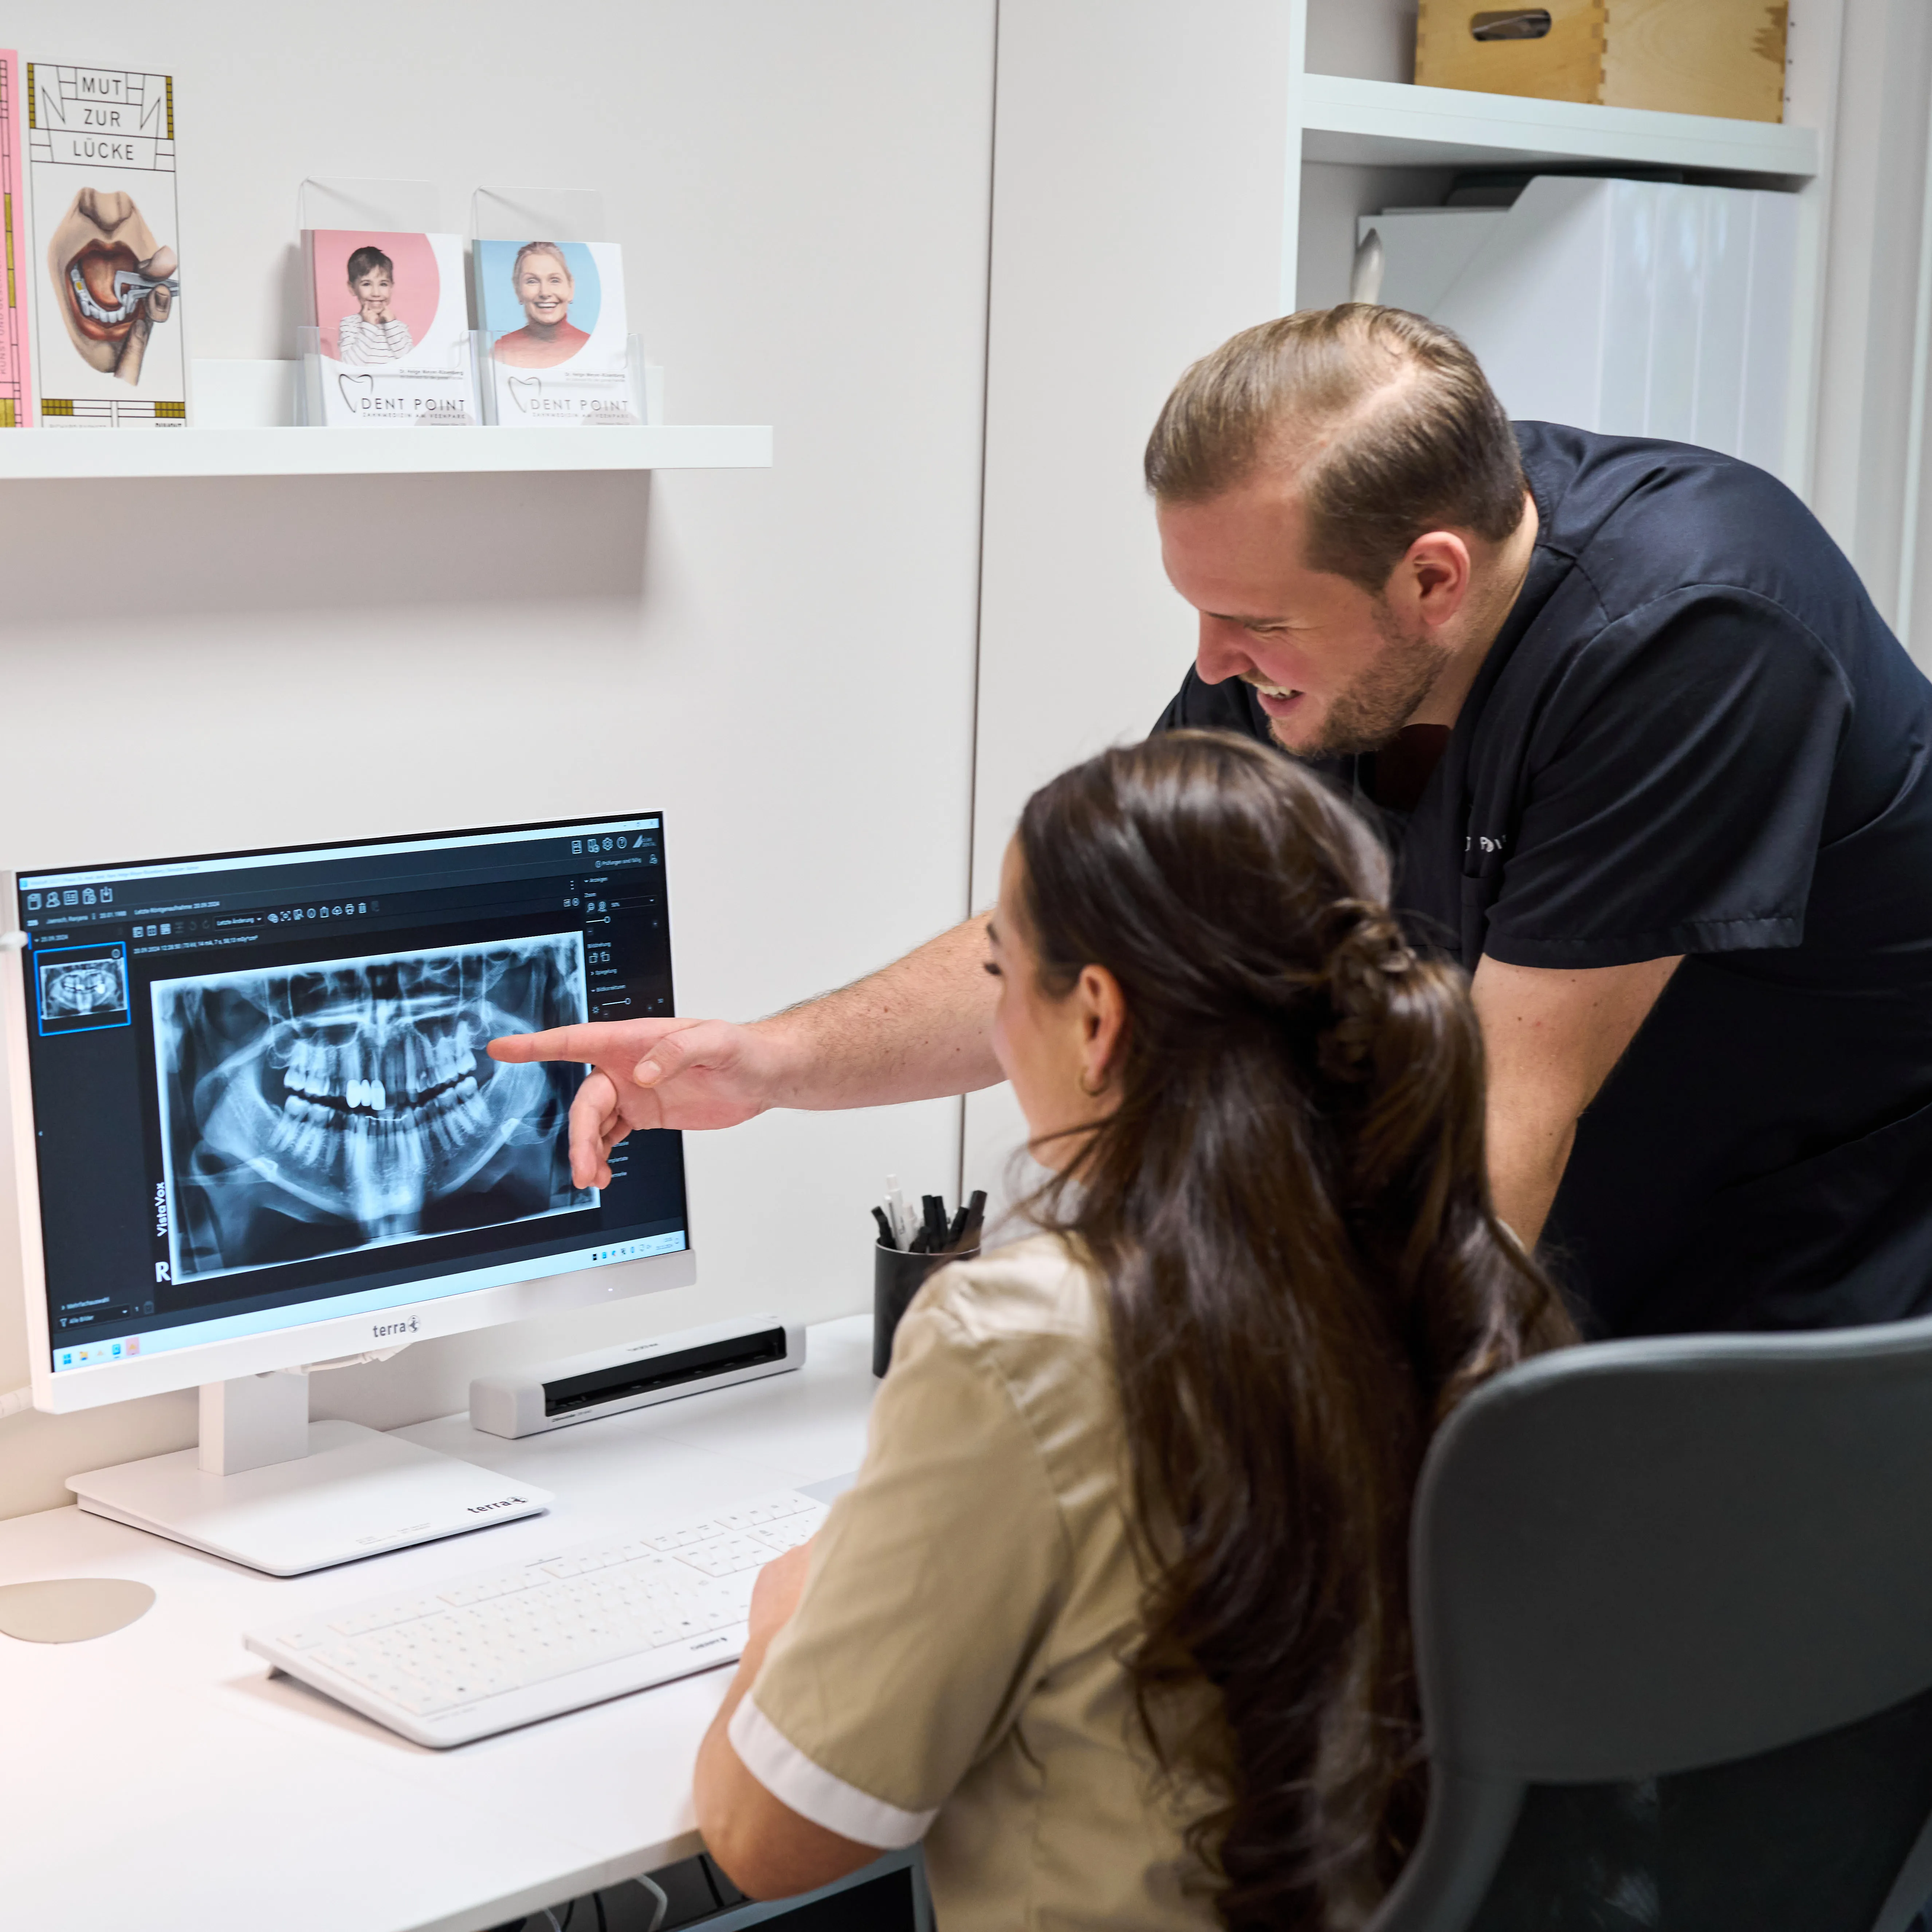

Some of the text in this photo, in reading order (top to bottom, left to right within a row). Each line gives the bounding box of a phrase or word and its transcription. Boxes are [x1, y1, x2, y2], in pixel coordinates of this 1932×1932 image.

[83, 77, 121, 95] MUT
[84, 109, 120, 127] ZUR
[74, 137, 134, 160] LÜCKE
[361, 398, 465, 411] DENT POINT
[530, 399, 628, 411] DENT POINT
[154, 1182, 168, 1237] VistaVox
[155, 1261, 171, 1283] R
[373, 1322, 406, 1338] terra
[467, 1501, 513, 1513] terra
